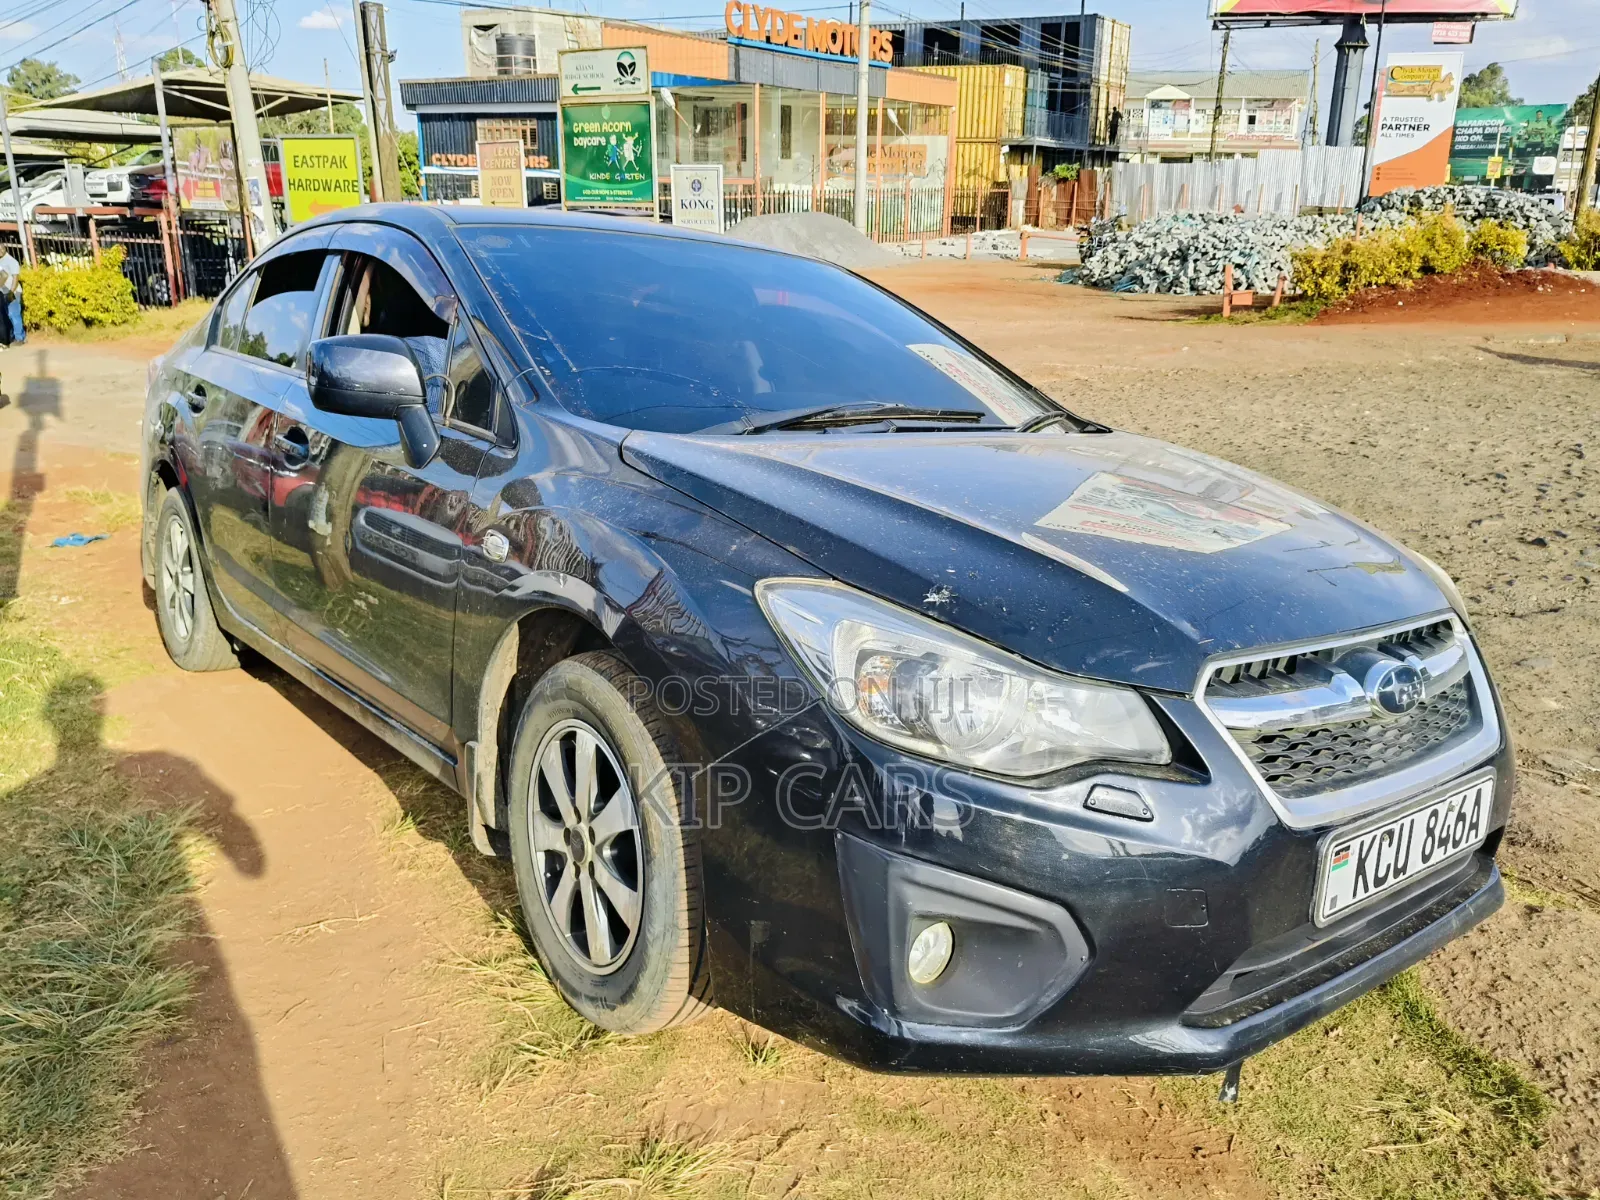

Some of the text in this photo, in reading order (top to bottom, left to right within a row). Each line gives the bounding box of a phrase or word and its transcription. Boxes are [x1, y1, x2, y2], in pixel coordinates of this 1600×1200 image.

[725, 0, 804, 49] CLYDE
[573, 122, 600, 133] Green
[1456, 119, 1505, 127] SAFARICOM
[1455, 127, 1483, 135] CHAPA
[573, 136, 607, 149] Daycare
[494, 146, 520, 157] LEXUS
[292, 155, 348, 168] EASTPAK
[431, 153, 478, 166] CLYDE
[484, 158, 517, 169] CENTRE
[491, 176, 512, 186] NOW
[589, 173, 646, 181] KINDEGARTEN
[288, 178, 360, 193] HARDWARE
[489, 188, 515, 198] OPEN
[680, 199, 714, 210] KONG
[1352, 788, 1482, 899] KCU 846A
